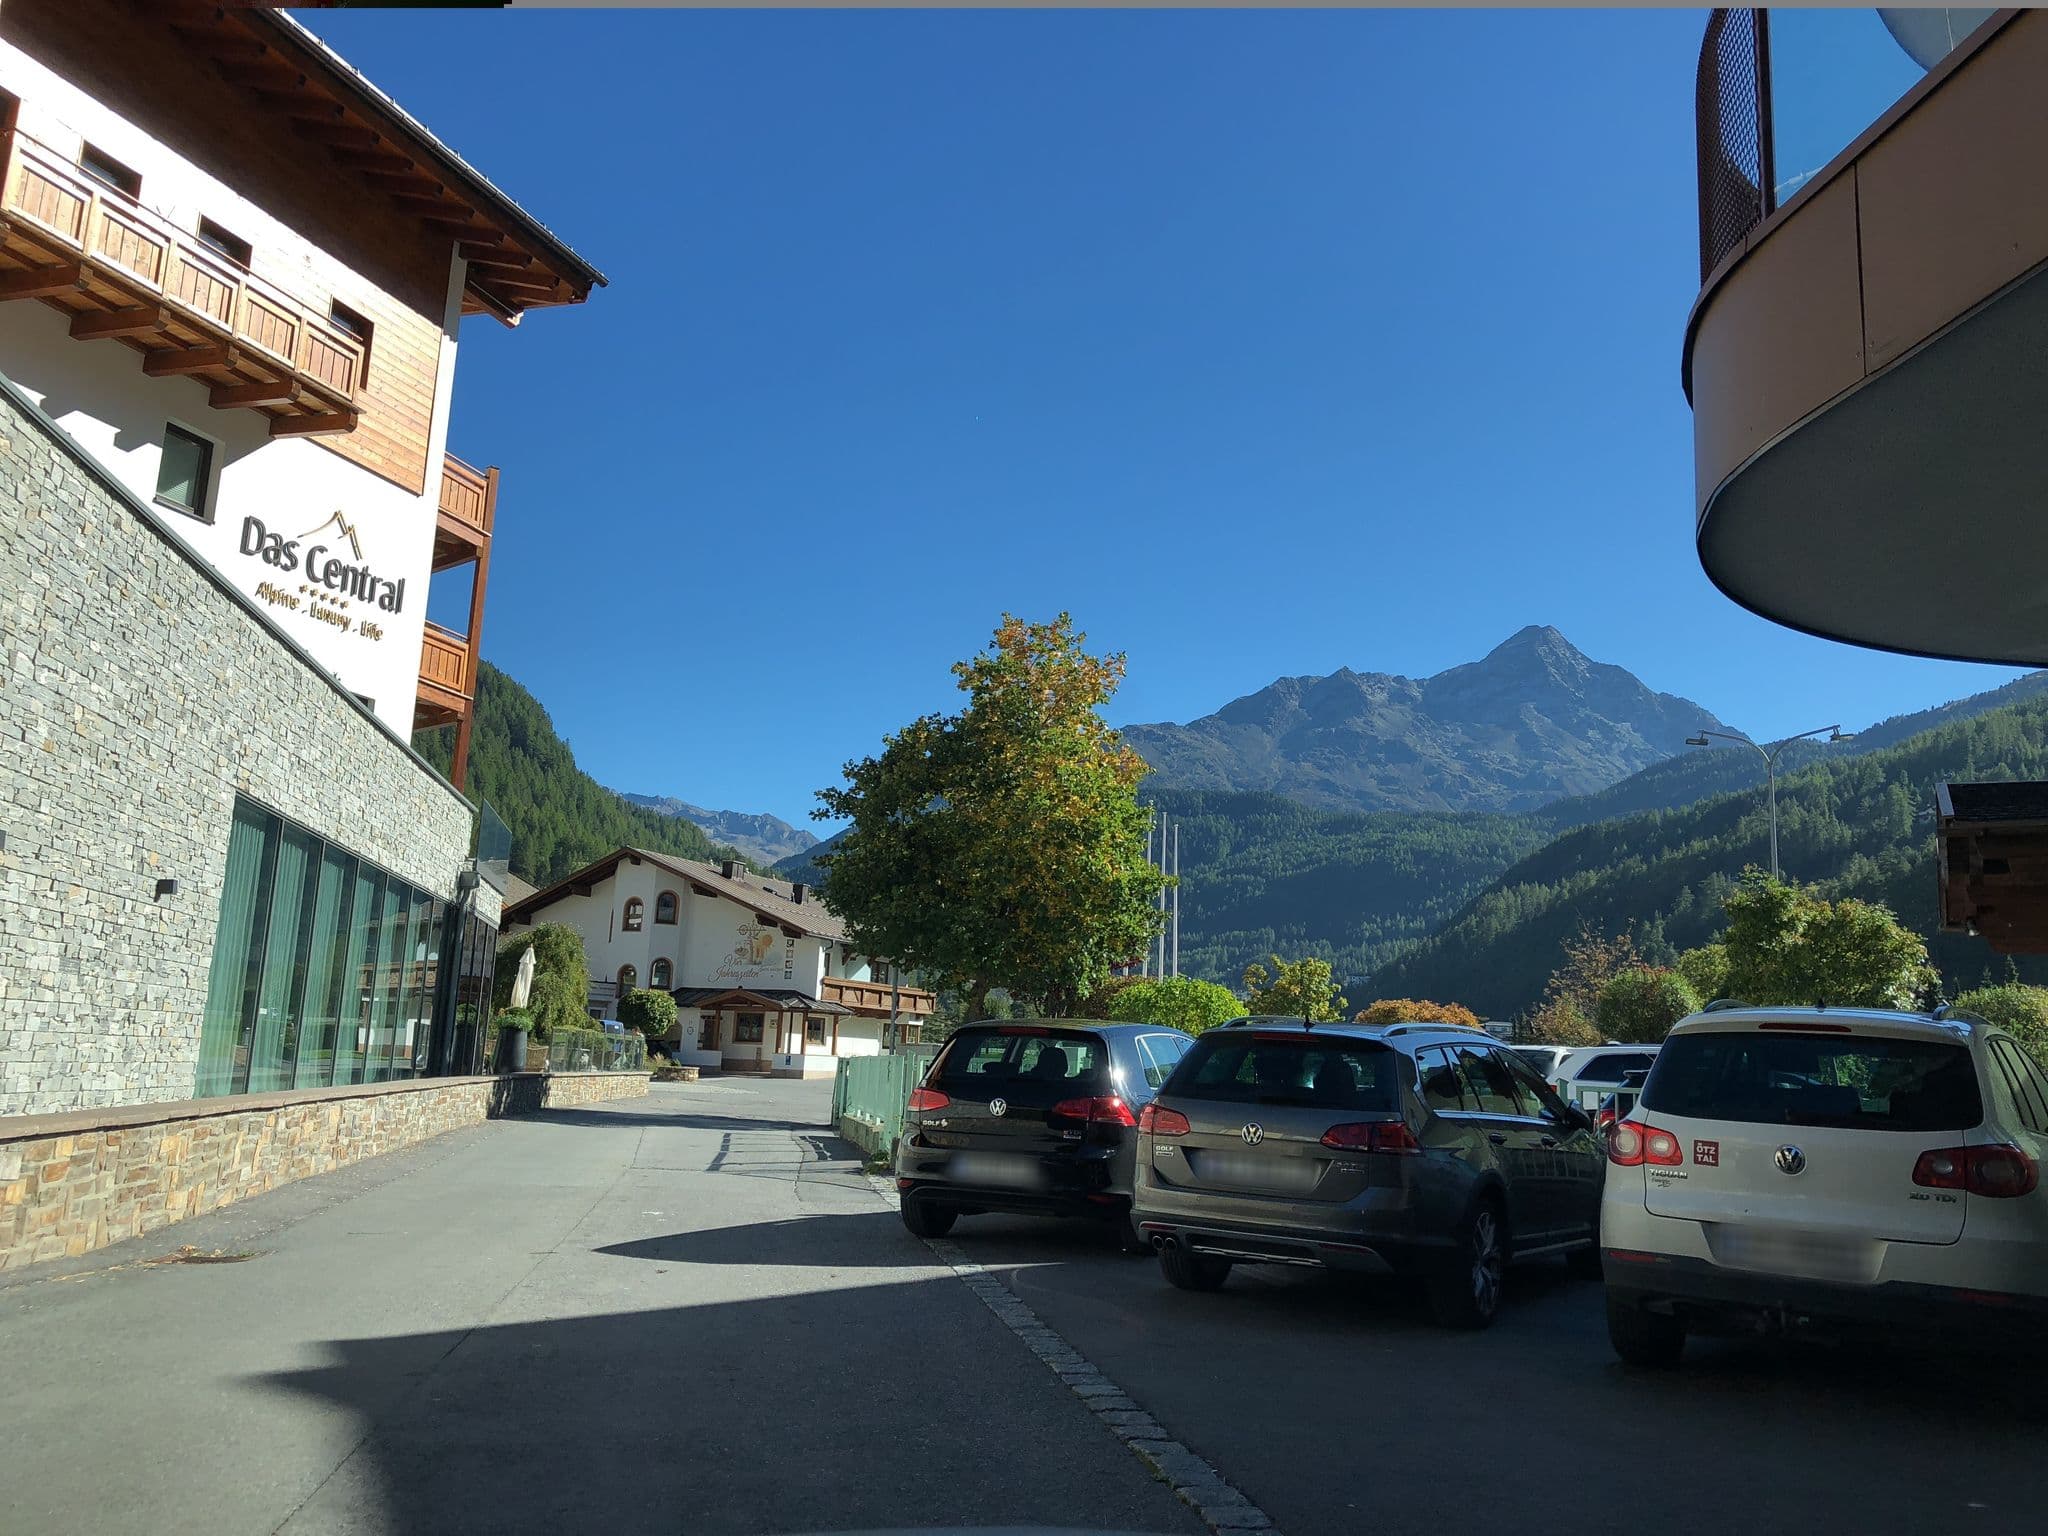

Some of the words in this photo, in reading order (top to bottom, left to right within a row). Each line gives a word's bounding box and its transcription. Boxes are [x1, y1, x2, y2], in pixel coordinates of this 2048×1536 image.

[240, 515, 300, 571] Das
[305, 545, 405, 615] Central
[255, 581, 300, 610] Alpine
[1696, 1142, 1716, 1154] ÖTZ
[1696, 1154, 1716, 1163] TAL
[1649, 1168, 1688, 1179] TIGUAN
